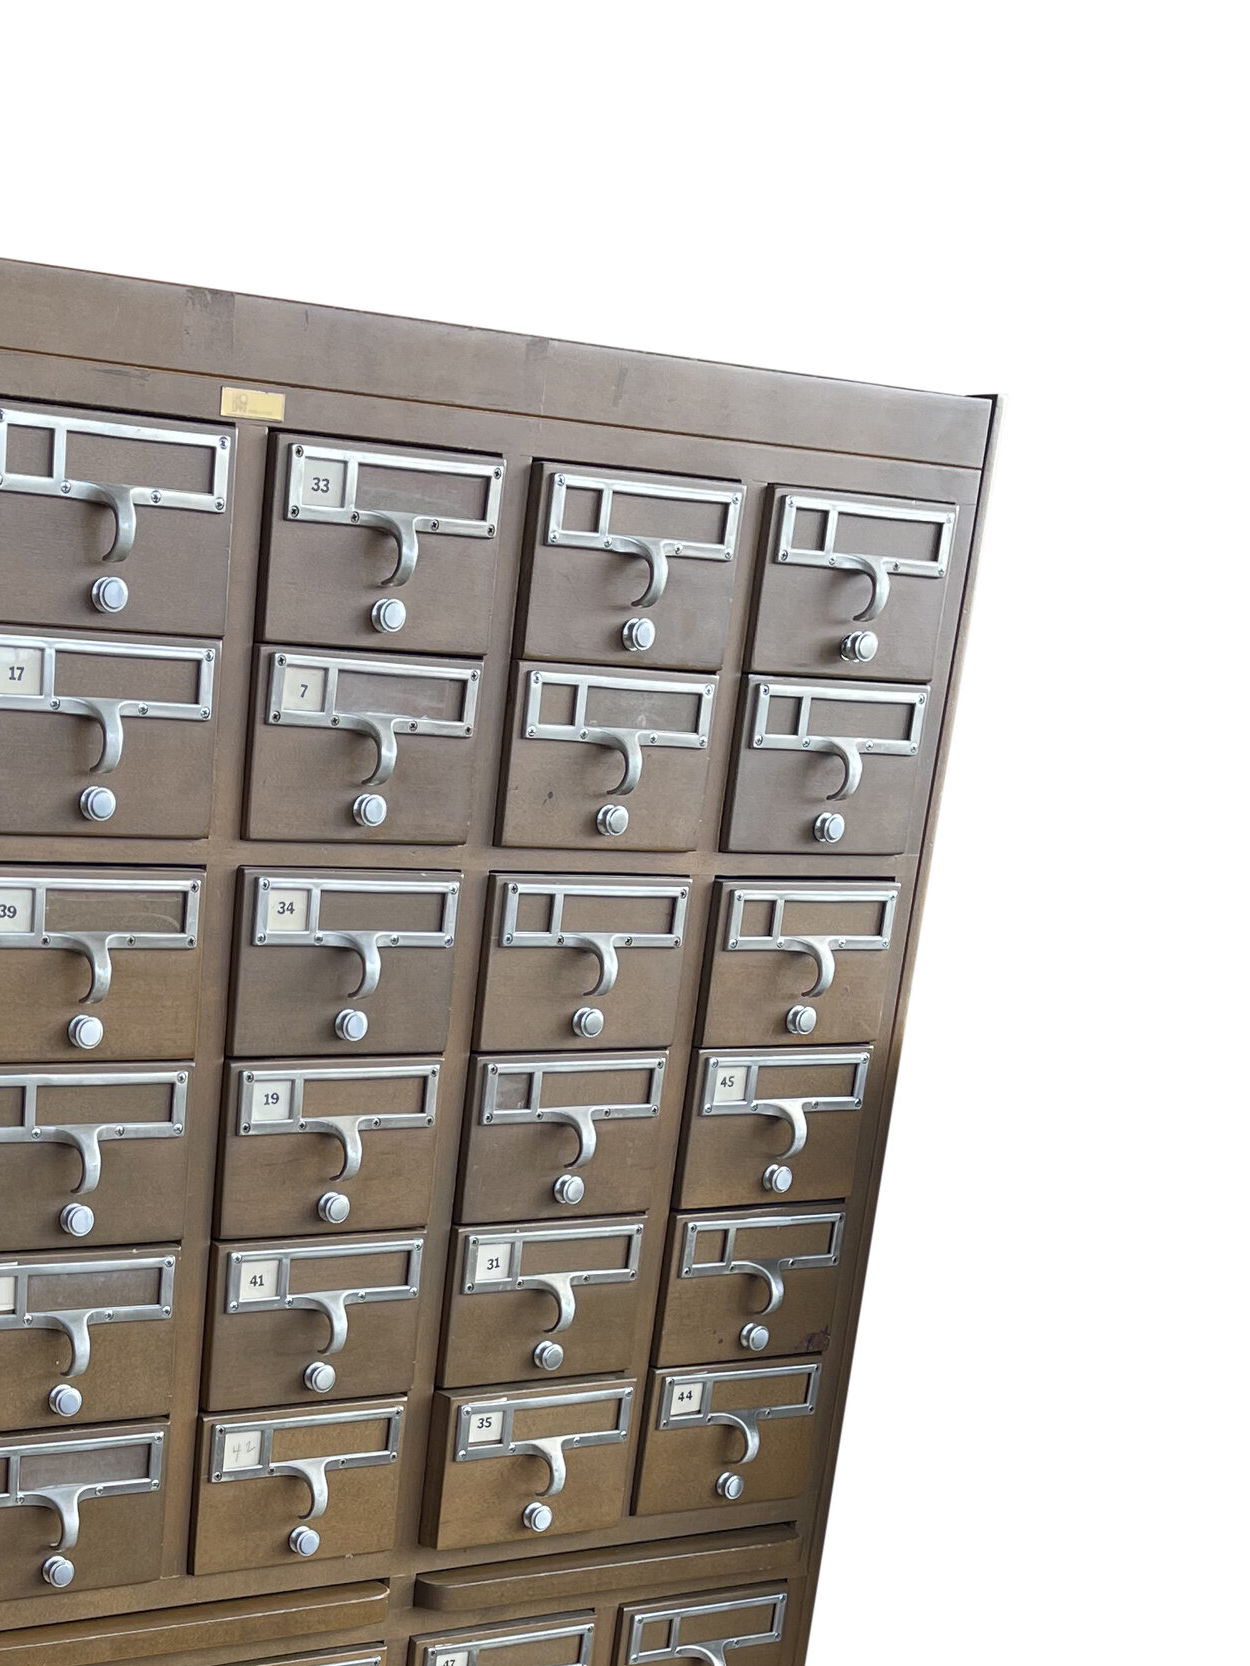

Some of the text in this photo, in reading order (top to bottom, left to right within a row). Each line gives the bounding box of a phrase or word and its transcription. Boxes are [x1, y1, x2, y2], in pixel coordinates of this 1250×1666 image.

[311, 476, 330, 494] 33
[8, 665, 25, 681] 17
[300, 683, 309, 698] 7
[277, 901, 295, 915] 34
[720, 1075, 735, 1088] 45
[263, 1092, 280, 1106] 19
[486, 1257, 500, 1271] 31
[249, 1274, 265, 1287] 41
[678, 1390, 693, 1402] 44
[477, 1416, 492, 1429] 35
